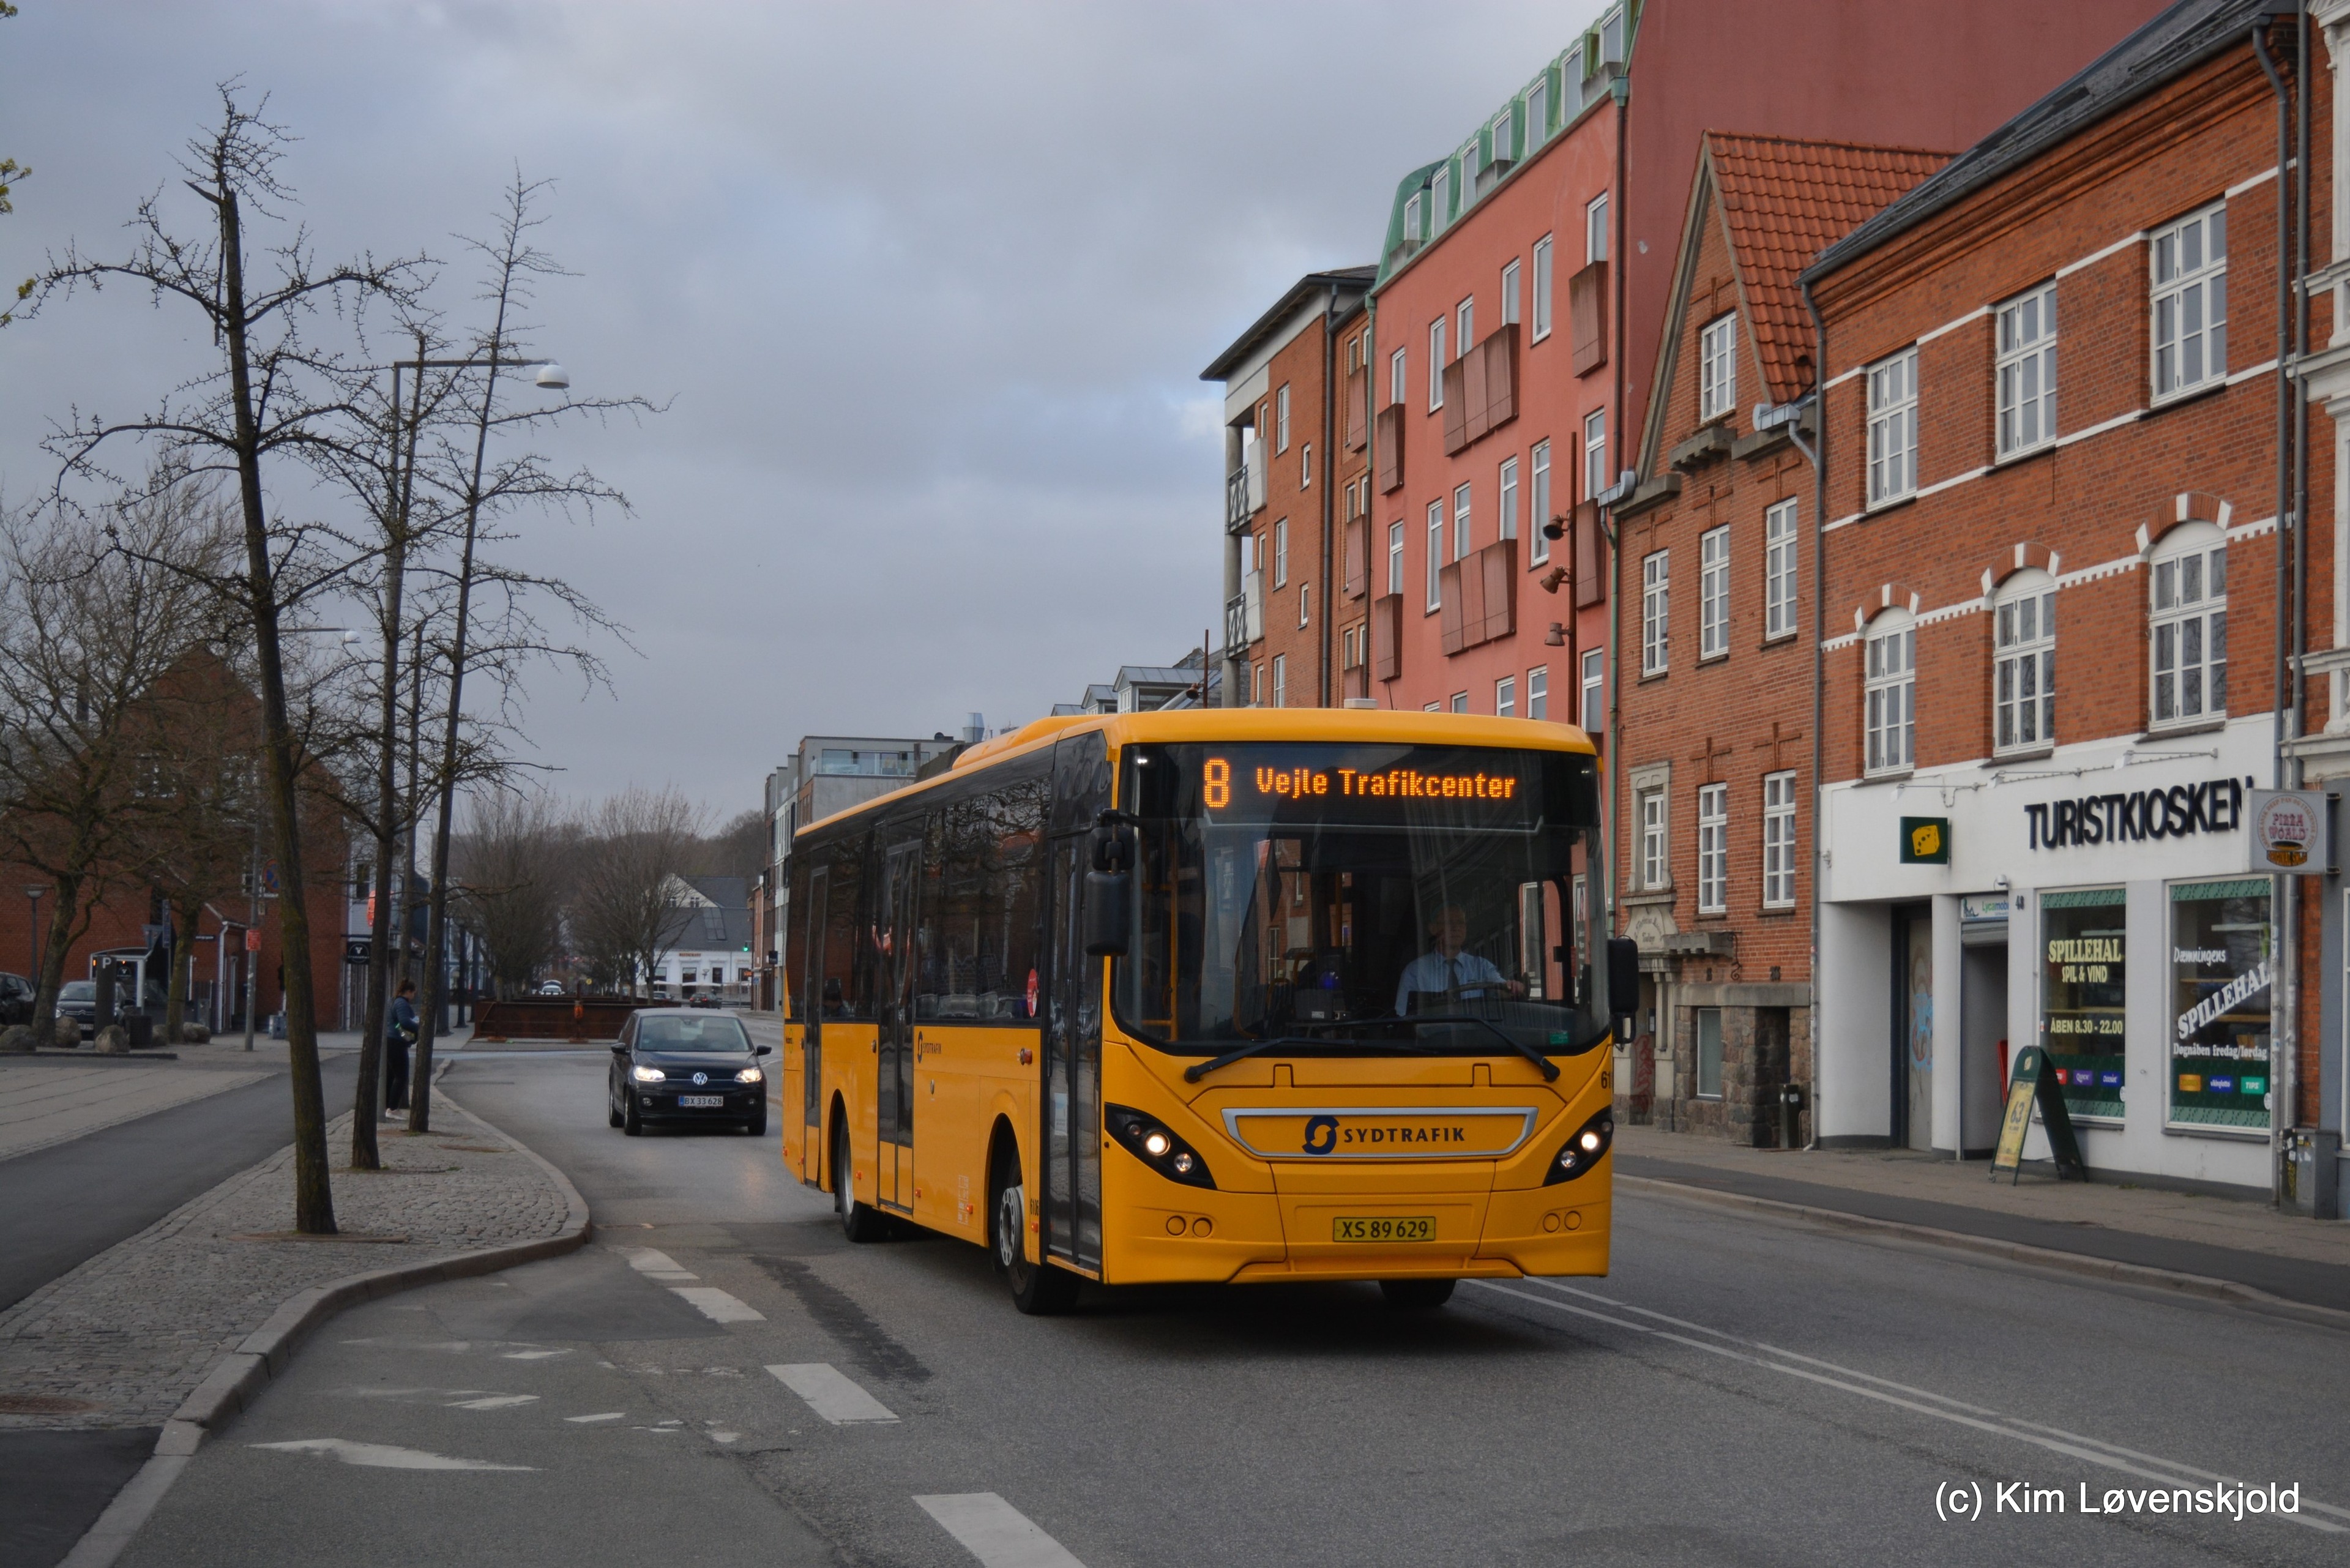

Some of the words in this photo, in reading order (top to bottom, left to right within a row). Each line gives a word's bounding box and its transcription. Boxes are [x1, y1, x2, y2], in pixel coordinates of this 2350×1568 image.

[1204, 759, 1229, 808] 8
[1257, 767, 1328, 799] Vejle
[1338, 769, 1515, 798] Trafikcenter
[2024, 775, 2253, 849] TURISTKIOSKEN
[2272, 813, 2303, 827] PIZZA
[2048, 939, 2121, 963] SPILLEHAL
[2173, 946, 2226, 967] Dæmningens
[103, 957, 111, 969] P
[2062, 965, 2076, 982] SPIL
[2078, 965, 2085, 982] &
[2087, 965, 2108, 982] VIND
[2177, 961, 2270, 1039] SPILLEHAL
[2050, 1017, 2073, 1033] ÅBEN
[2075, 1020, 2092, 1033] 8.30
[2100, 1020, 2123, 1034] 22.00
[923, 1042, 942, 1054] SYDTRAFIK
[1344, 1127, 1465, 1143] SYDTRAFIK
[1341, 1221, 1365, 1238] XS
[1370, 1220, 1391, 1238] 89
[1396, 1220, 1428, 1238] 629
